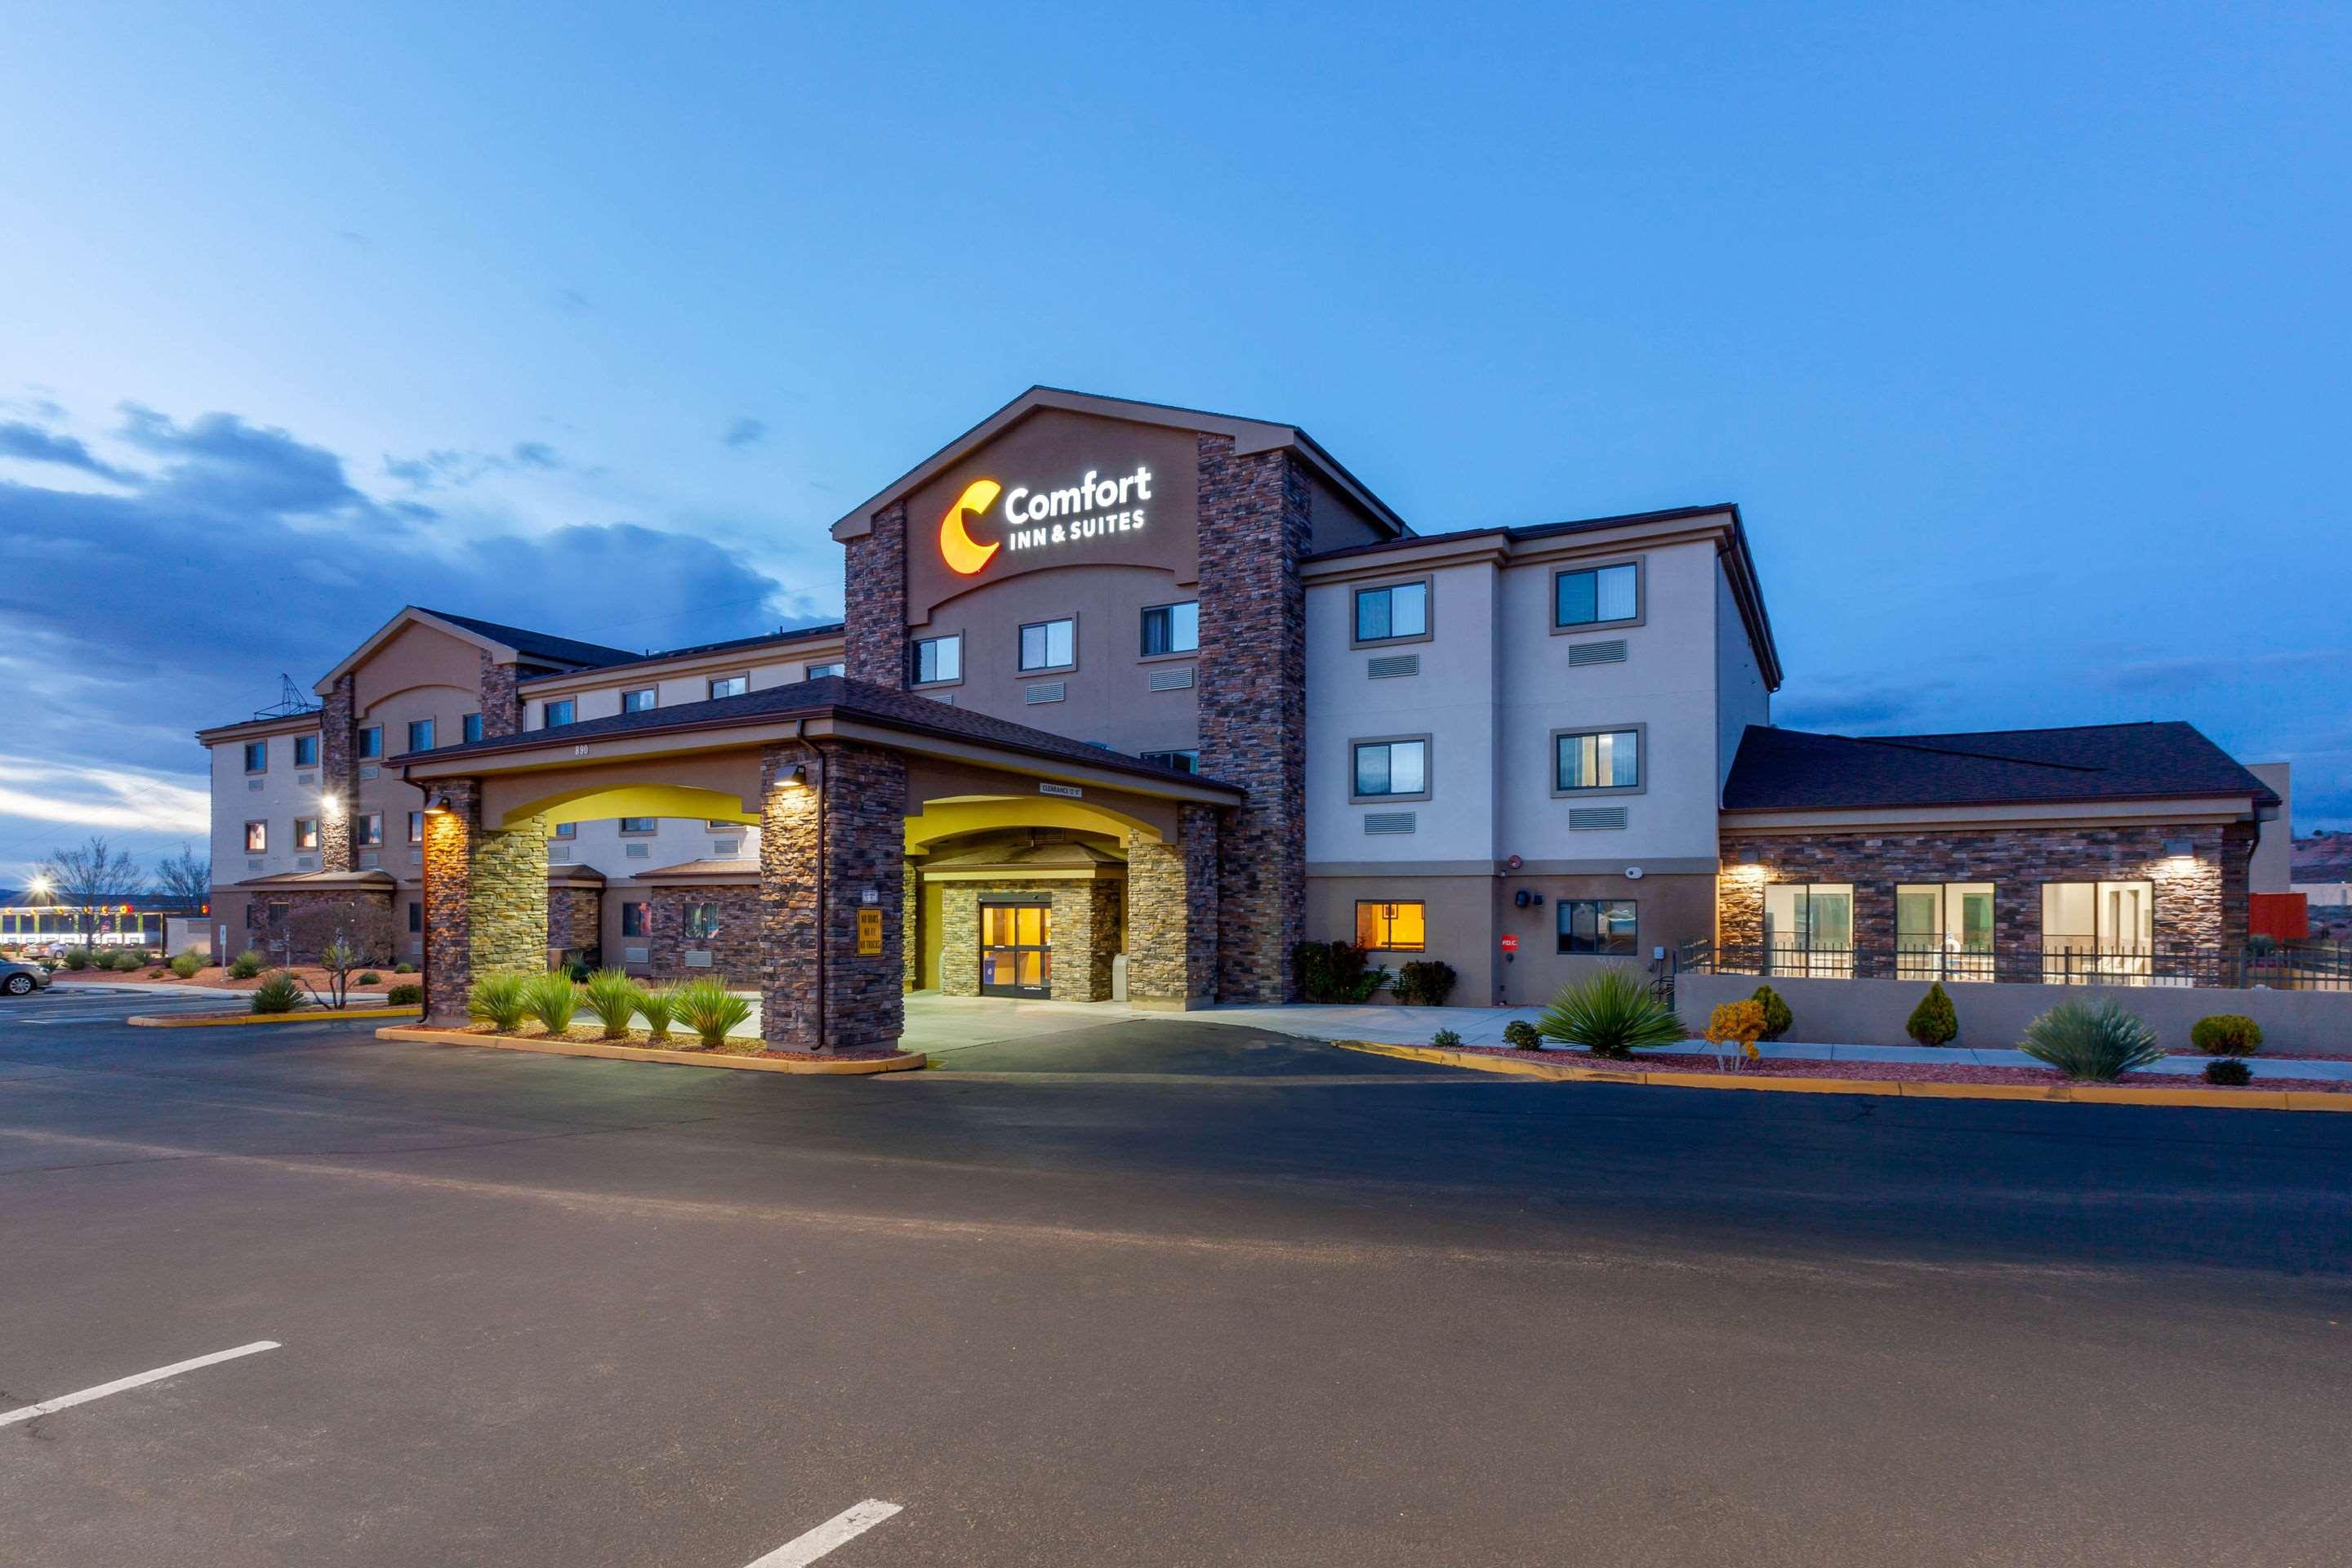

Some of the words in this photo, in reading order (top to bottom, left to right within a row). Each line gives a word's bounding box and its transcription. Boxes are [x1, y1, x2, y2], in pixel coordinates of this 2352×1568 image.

[1005, 466, 1152, 524] Comfort
[1010, 528, 1046, 550] INN
[1051, 524, 1066, 543] &
[1070, 510, 1145, 539] SUITES
[575, 745, 588, 755] 890
